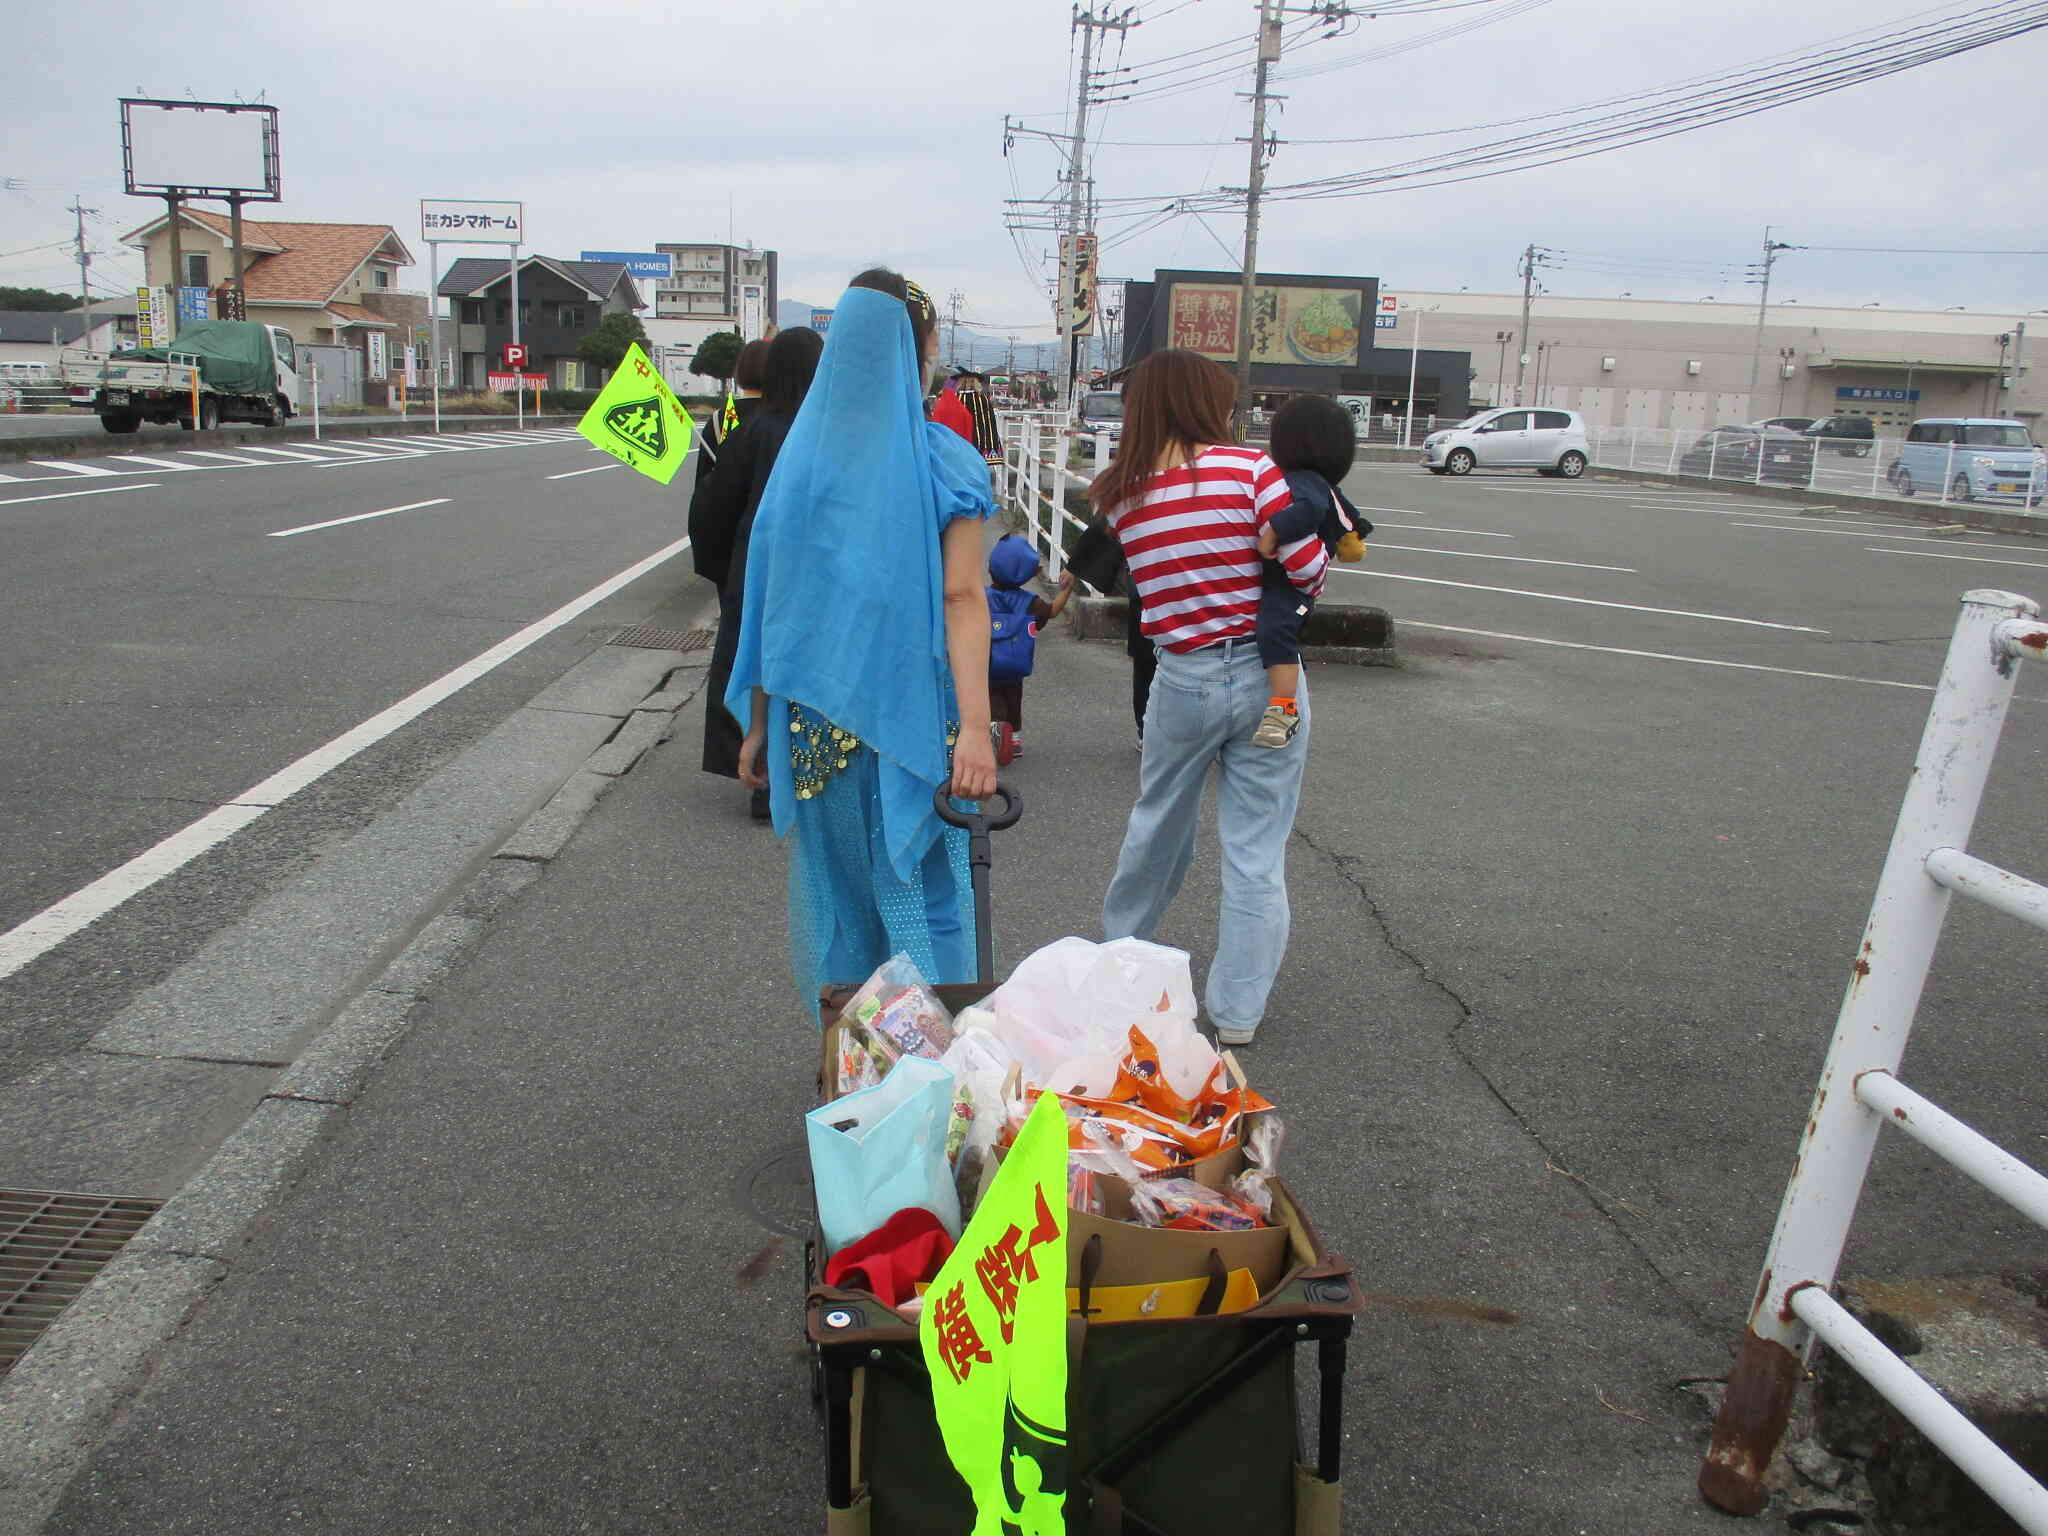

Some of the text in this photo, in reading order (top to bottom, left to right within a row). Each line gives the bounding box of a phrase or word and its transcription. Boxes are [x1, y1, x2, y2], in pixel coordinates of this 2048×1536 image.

[440, 214, 518, 229] カシマホーム
[635, 262, 668, 272] HOMES
[507, 347, 522, 363] P
